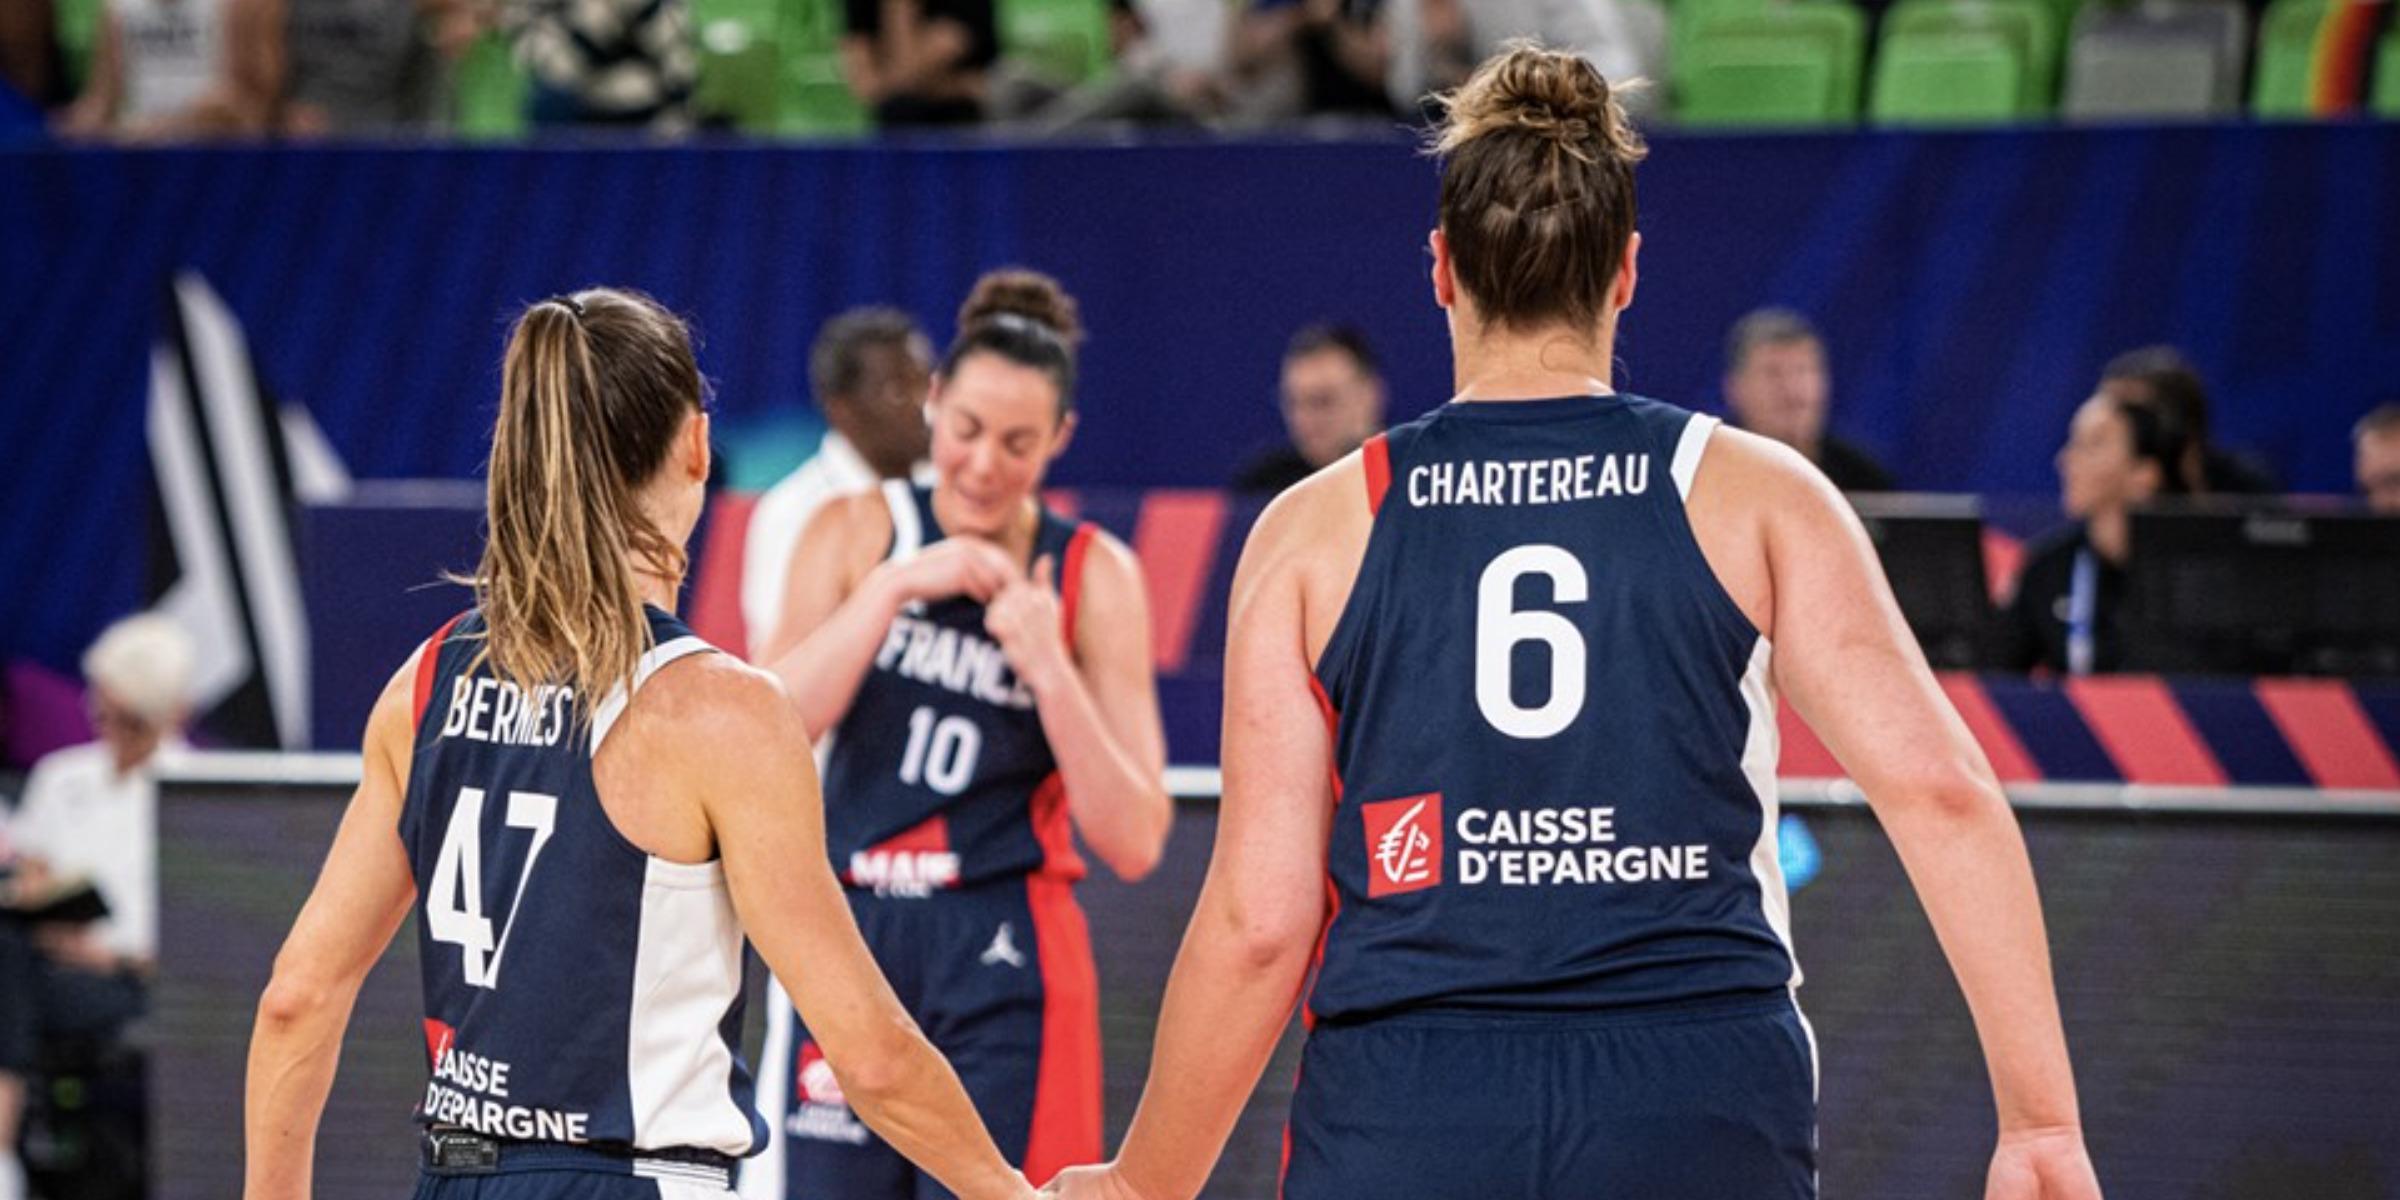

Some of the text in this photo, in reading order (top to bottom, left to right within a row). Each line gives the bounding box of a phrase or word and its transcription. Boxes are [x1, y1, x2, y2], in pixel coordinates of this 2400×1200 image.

[1408, 453, 1649, 507] CHARTEREAU
[1475, 544, 1588, 739] 6
[898, 704, 983, 796] 10
[1456, 807, 1616, 845] CAISSE
[426, 785, 558, 989] 47
[1458, 845, 1710, 885] D'EPARGNE
